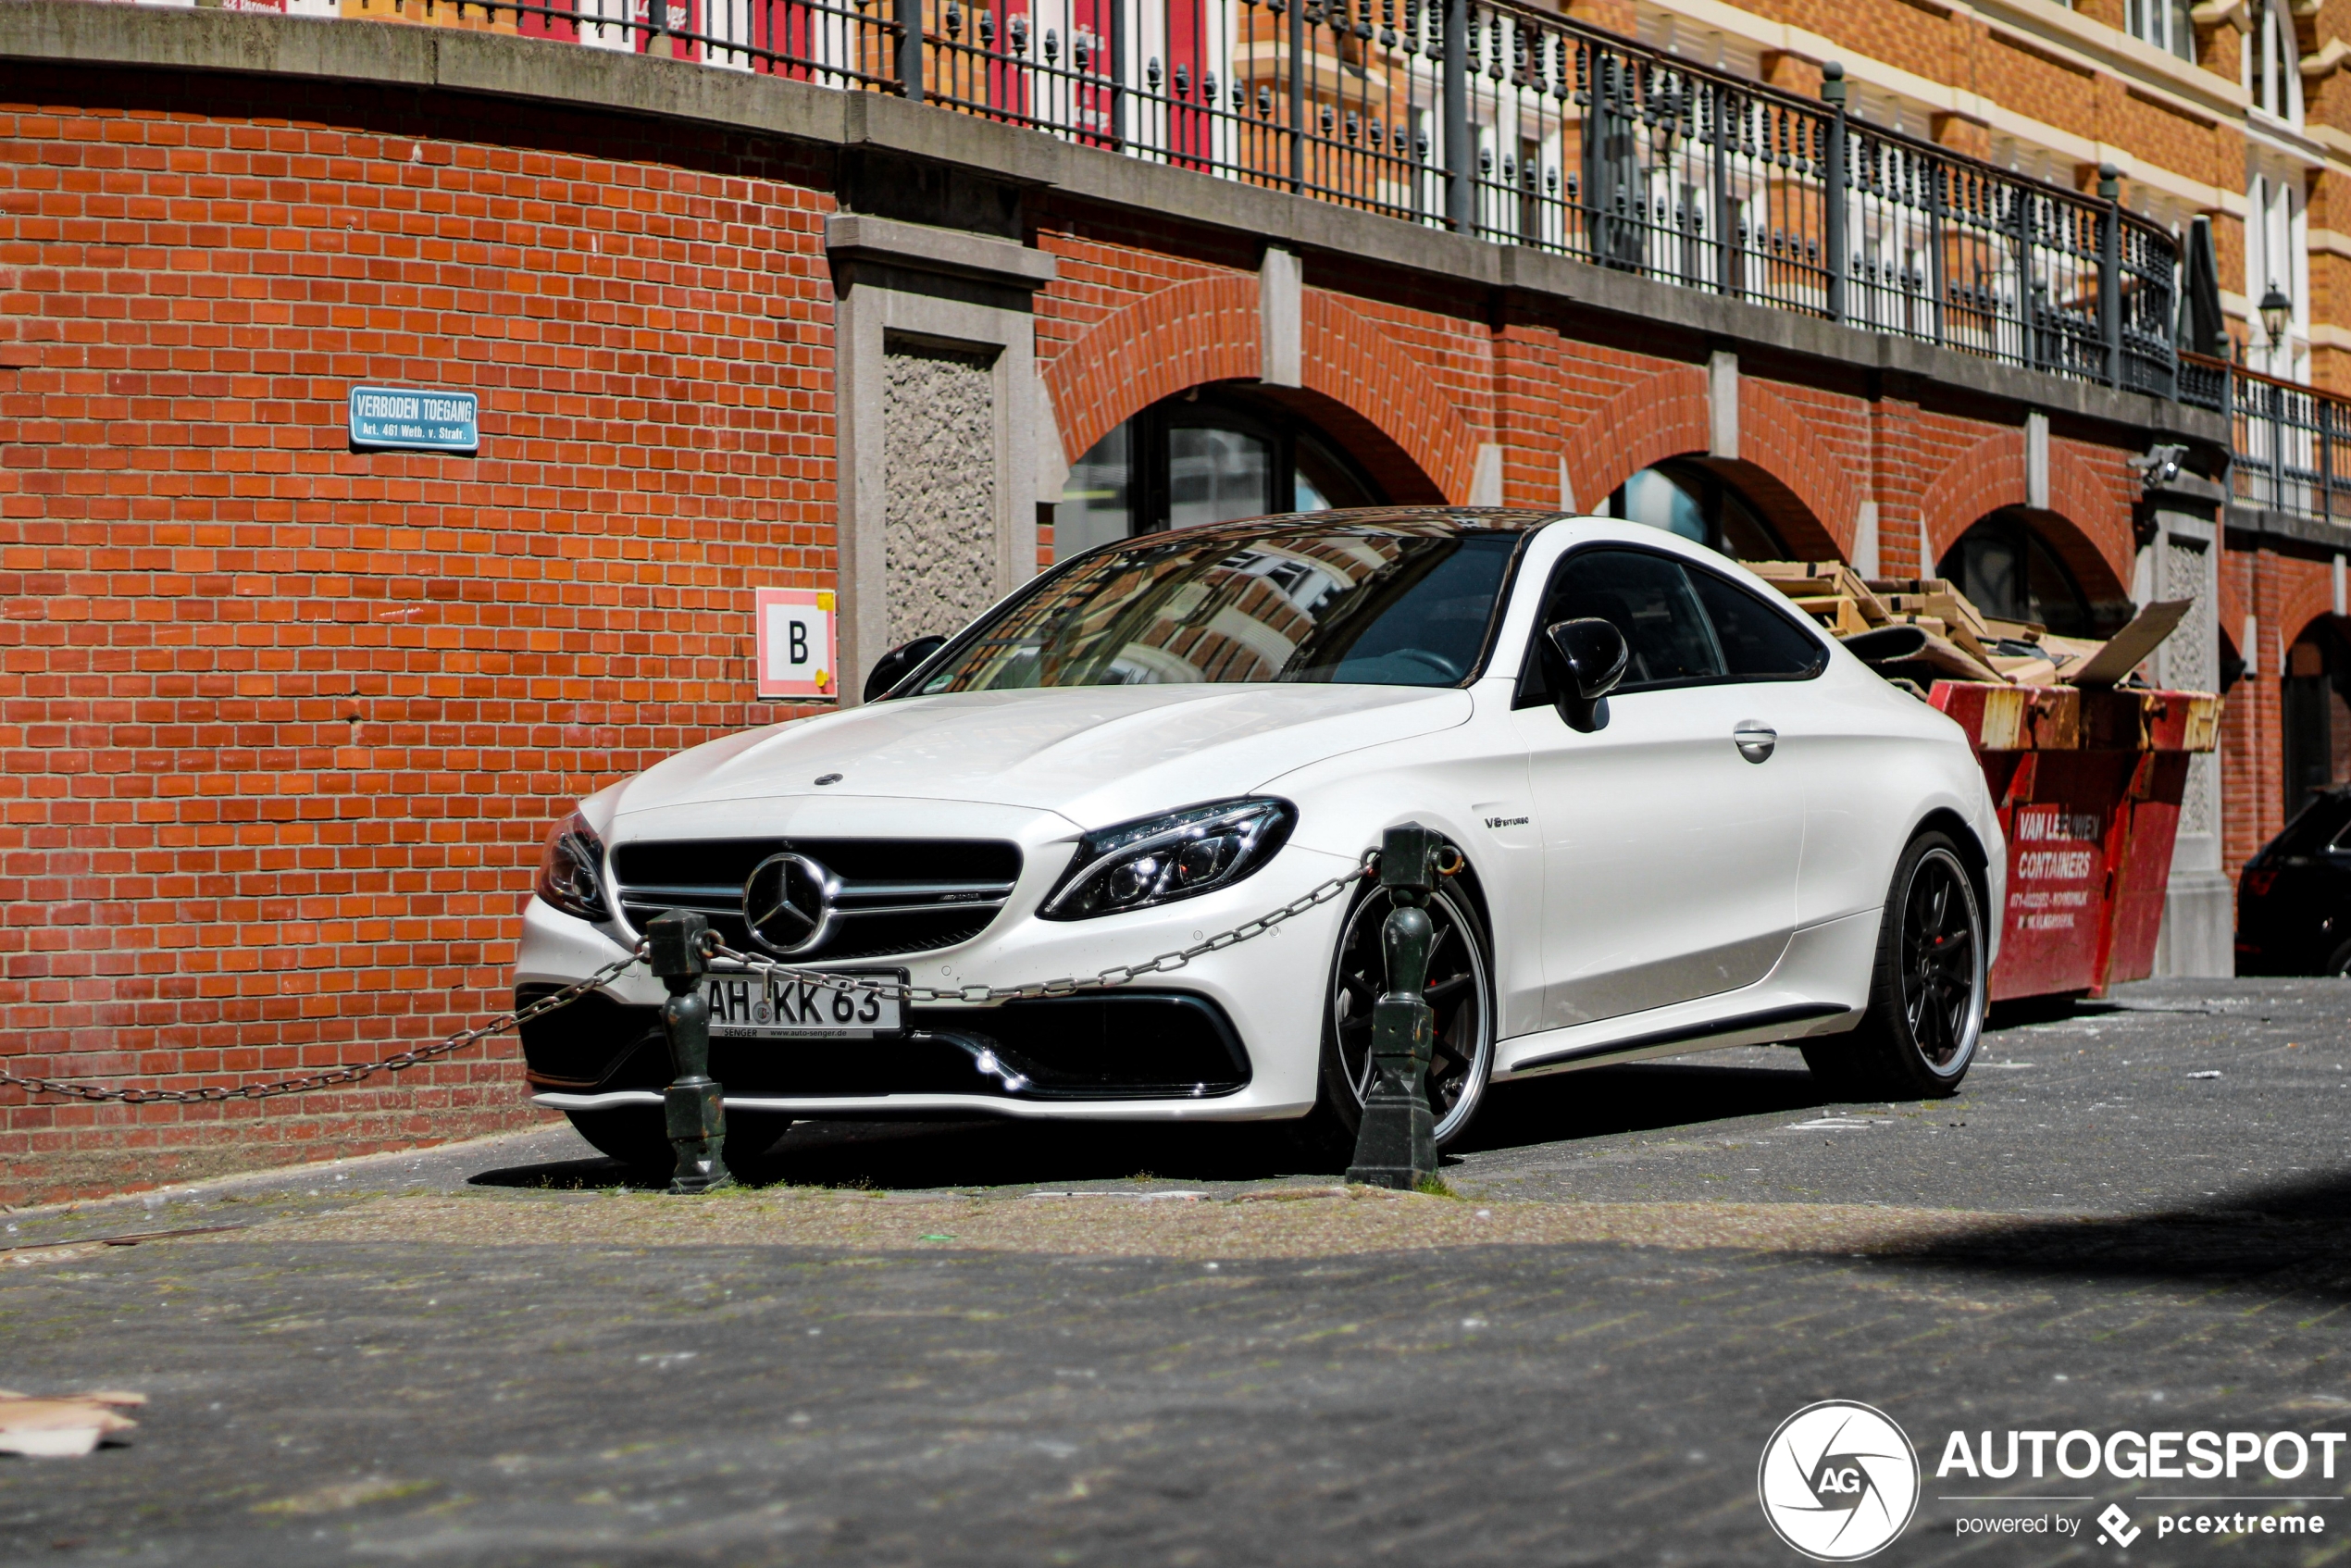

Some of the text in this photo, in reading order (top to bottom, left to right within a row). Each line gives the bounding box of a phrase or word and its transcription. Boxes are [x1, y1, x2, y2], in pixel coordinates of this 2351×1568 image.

[356, 394, 473, 422] VERBODEN TOEGANG
[363, 422, 467, 440] Art. 461 Wetb. v. Strafr.
[790, 620, 809, 665] B
[1484, 816, 1501, 828] V8
[2020, 813, 2045, 840] VAN
[2019, 851, 2091, 879] CONTAINERS
[709, 979, 881, 1023] AH KK 63
[724, 1028, 847, 1039] SENGER www.auto-senger.de
